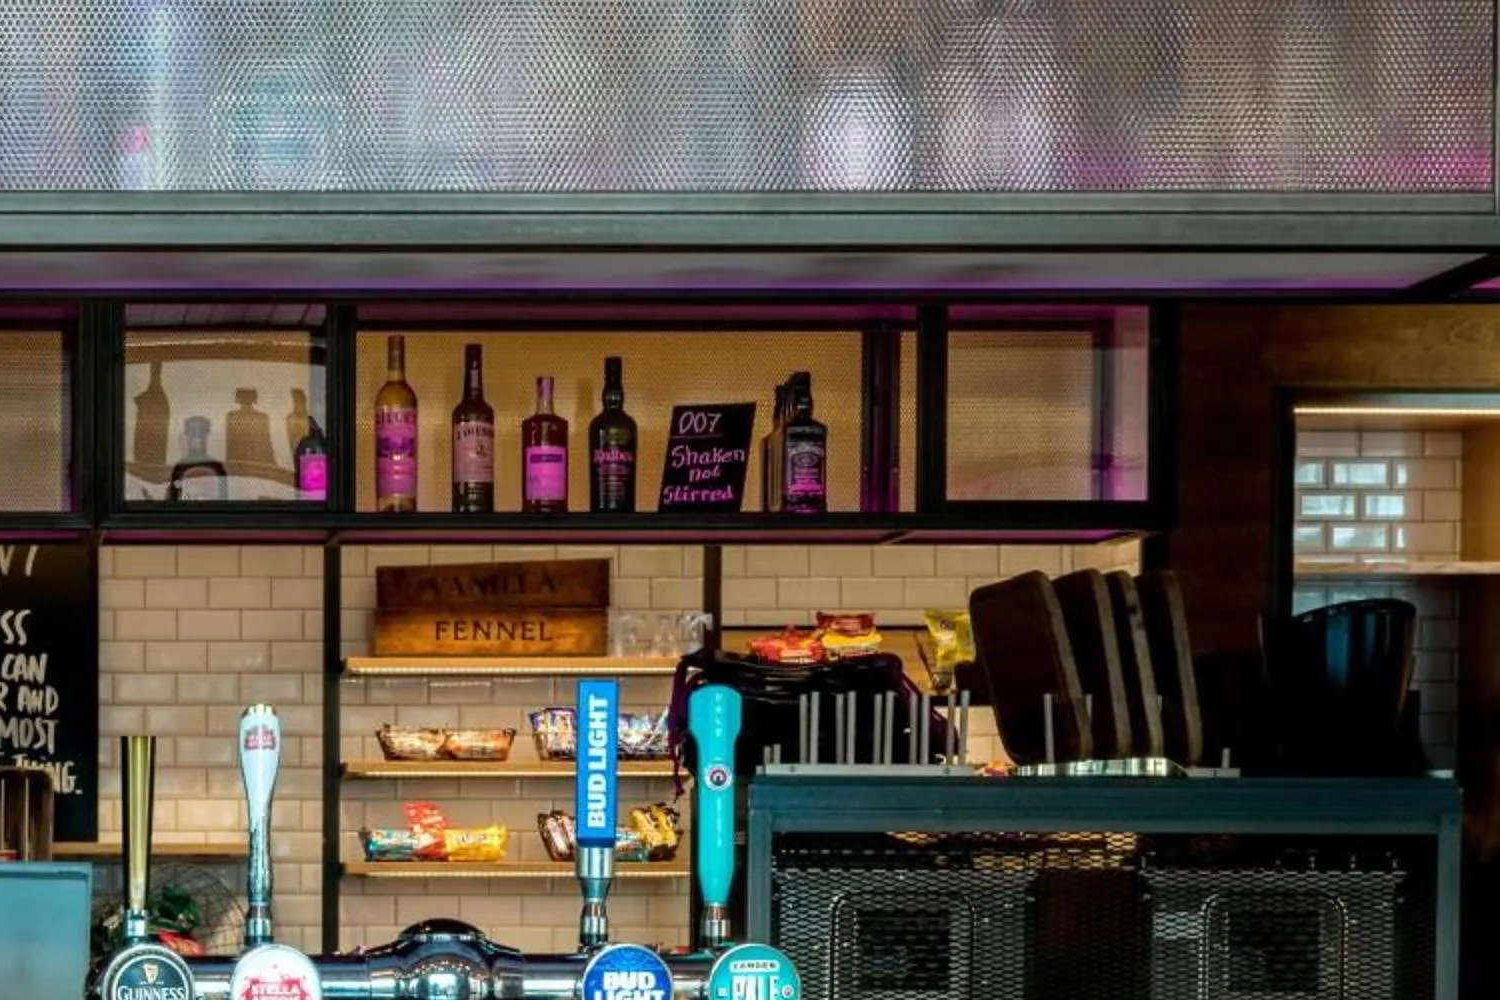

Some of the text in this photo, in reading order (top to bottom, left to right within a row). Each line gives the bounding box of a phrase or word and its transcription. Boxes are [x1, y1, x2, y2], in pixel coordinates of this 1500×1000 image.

[679, 411, 722, 434] 007
[689, 465, 722, 483] not
[663, 484, 735, 505] Stirred
[434, 620, 554, 642] FENNEL
[2, 653, 48, 684] CAN
[17, 685, 59, 716] AND
[587, 694, 610, 829] BUD LIGHT
[251, 983, 300, 996] STELLA
[603, 971, 657, 990] BUD
